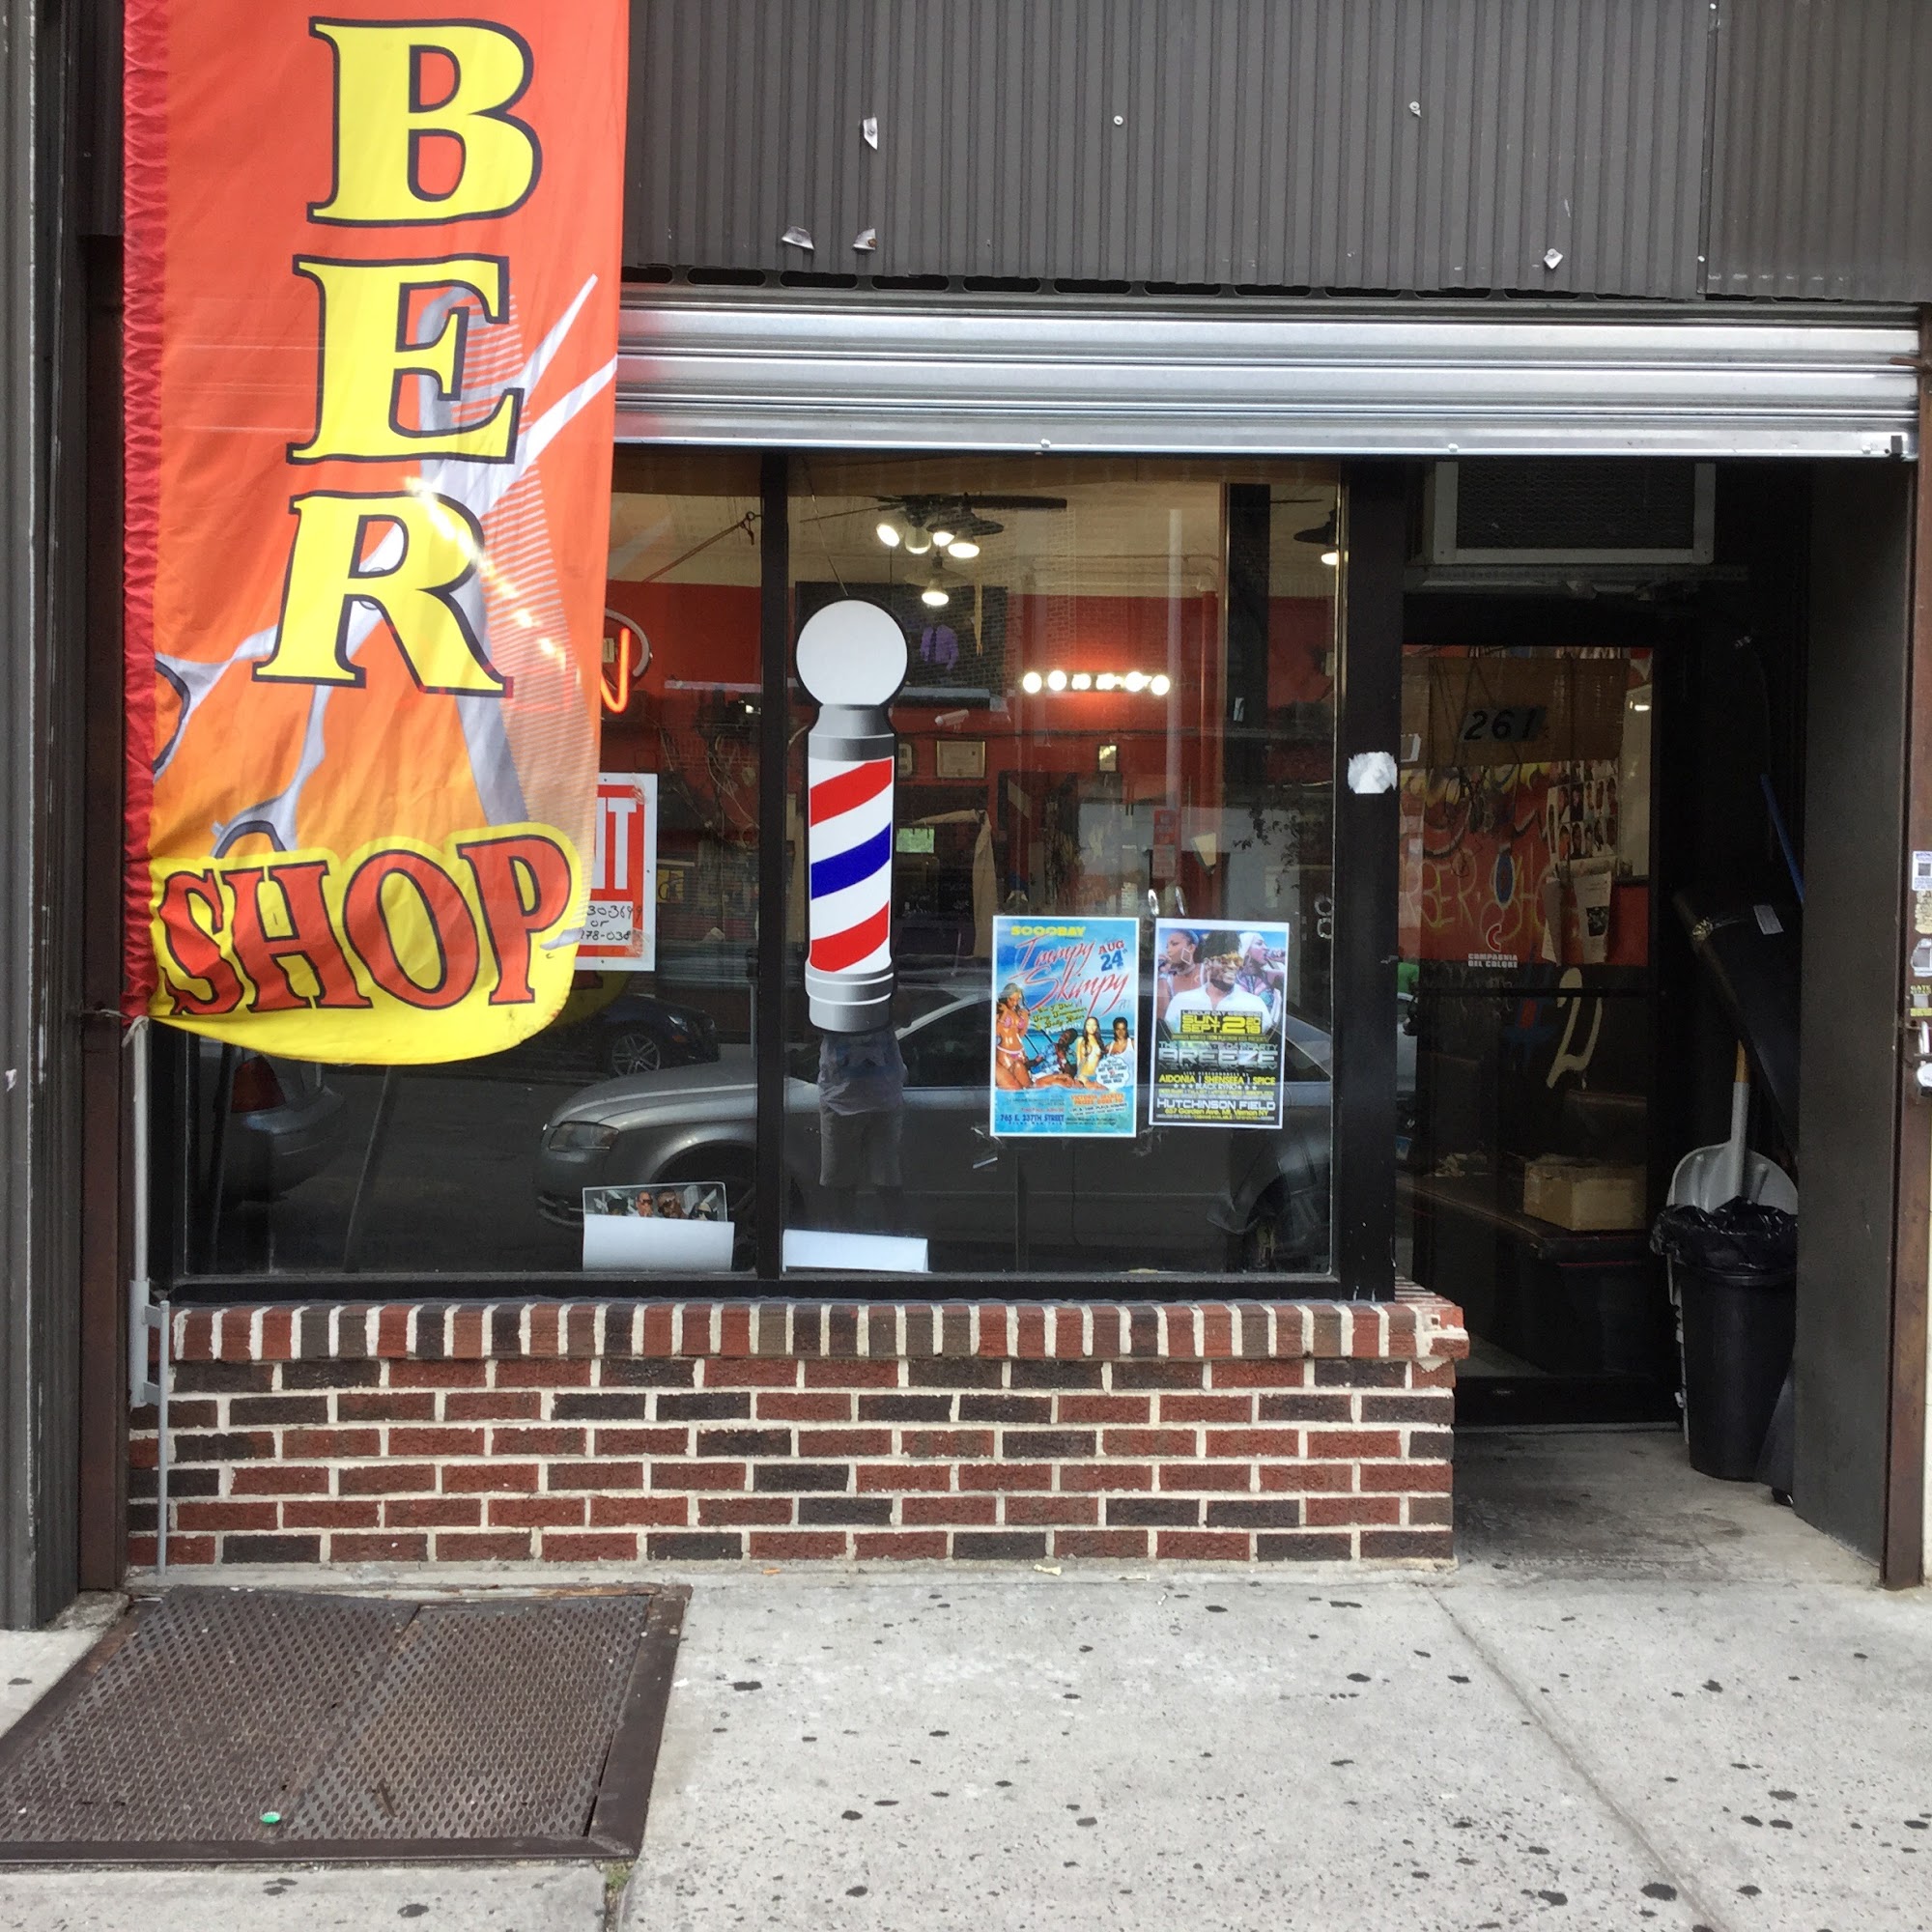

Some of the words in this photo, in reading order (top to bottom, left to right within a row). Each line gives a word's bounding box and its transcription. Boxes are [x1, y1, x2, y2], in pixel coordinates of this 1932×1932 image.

[1463, 708, 1537, 741] 261
[159, 833, 574, 1014] SHOP
[1098, 940, 1124, 954] AUG
[1008, 960, 1129, 1024] Skimpy
[1182, 1015, 1220, 1024] SUN.
[1221, 1016, 1246, 1034] 2
[1158, 1048, 1278, 1065] BREEZE
[1158, 1074, 1196, 1083] AIDONIA
[1252, 1076, 1276, 1085] SPICE
[1156, 1098, 1236, 1109] HUTCHINSON
[1238, 1100, 1276, 1111] FIELD
